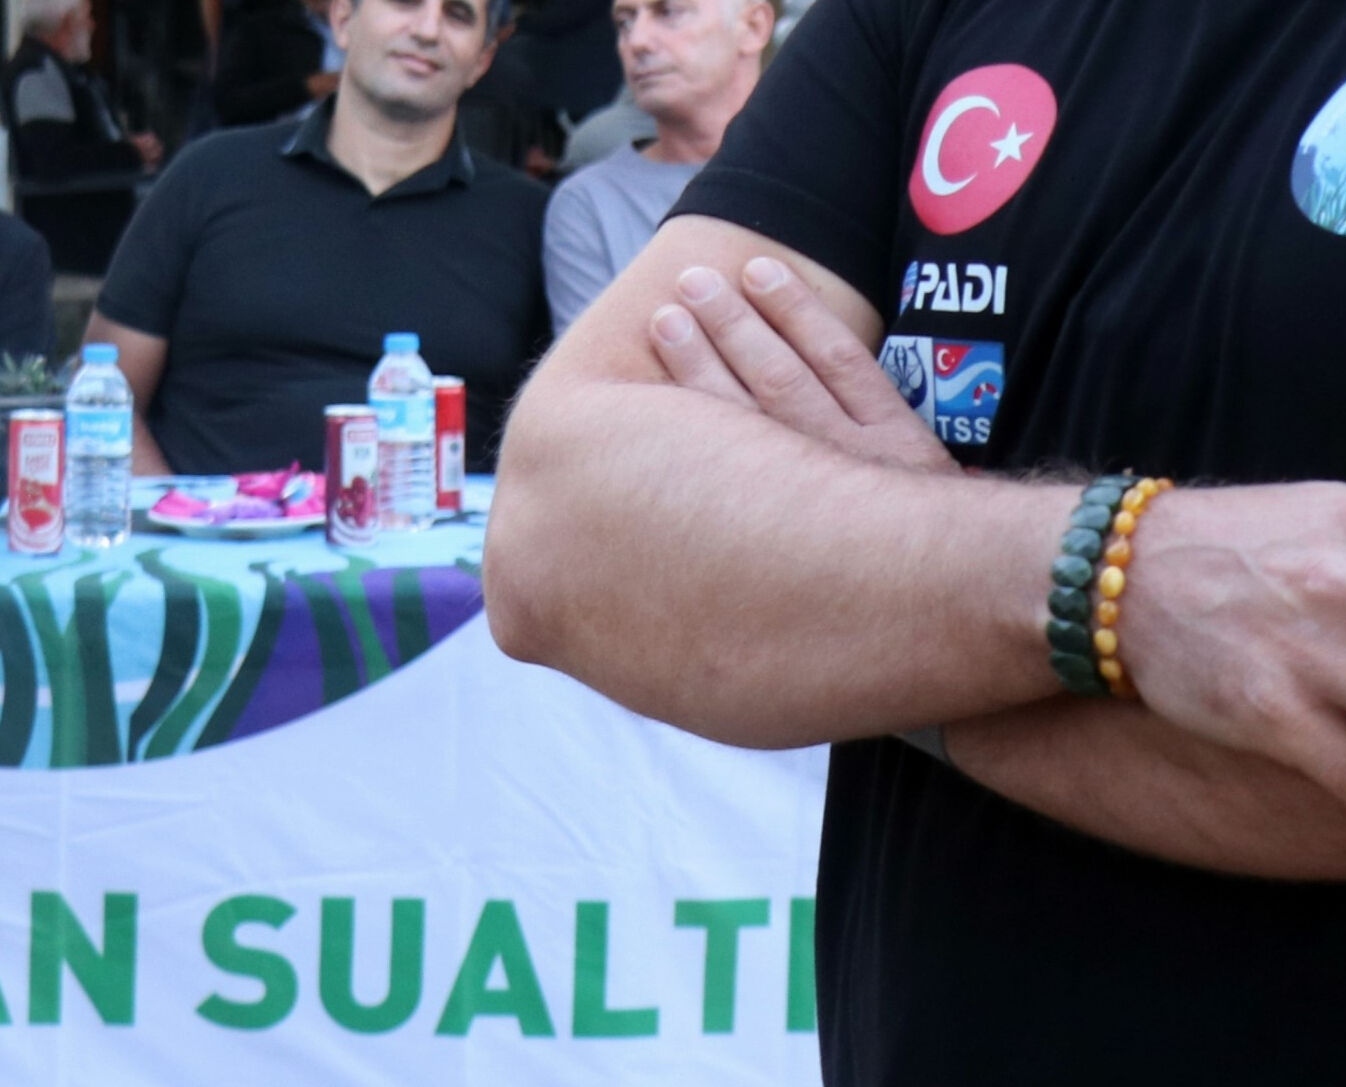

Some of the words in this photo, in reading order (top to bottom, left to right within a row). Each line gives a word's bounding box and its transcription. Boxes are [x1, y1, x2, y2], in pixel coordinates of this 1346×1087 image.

[914, 262, 1008, 315] PADI
[0, 890, 138, 1028] N
[195, 893, 817, 1039] SUALTI
